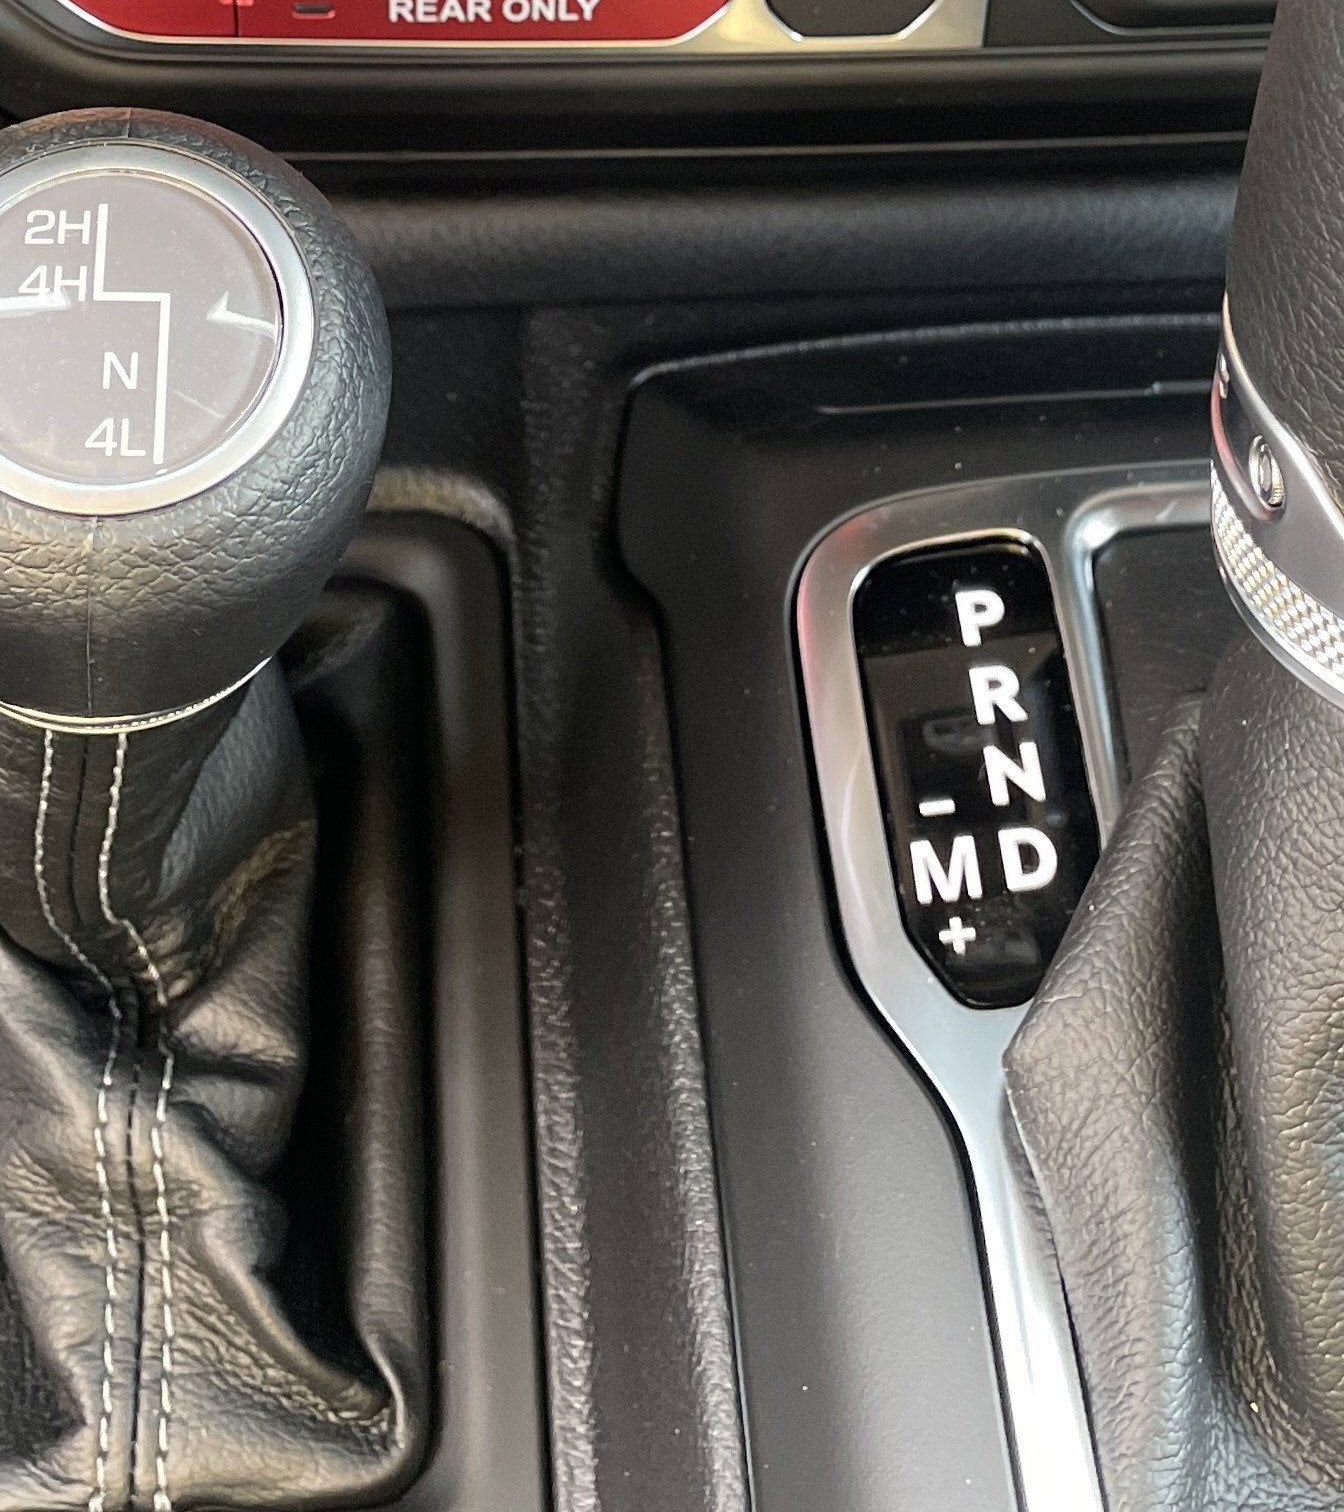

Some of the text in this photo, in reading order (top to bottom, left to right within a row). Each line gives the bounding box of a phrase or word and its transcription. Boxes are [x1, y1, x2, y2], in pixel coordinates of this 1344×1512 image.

[24, 209, 91, 245] 2H
[18, 265, 87, 302] 4H
[103, 352, 138, 389] N
[84, 416, 147, 457] 4L
[955, 588, 1006, 647] P
[968, 664, 1028, 725] R
[983, 741, 1046, 807] N
[910, 826, 1057, 906] M D
